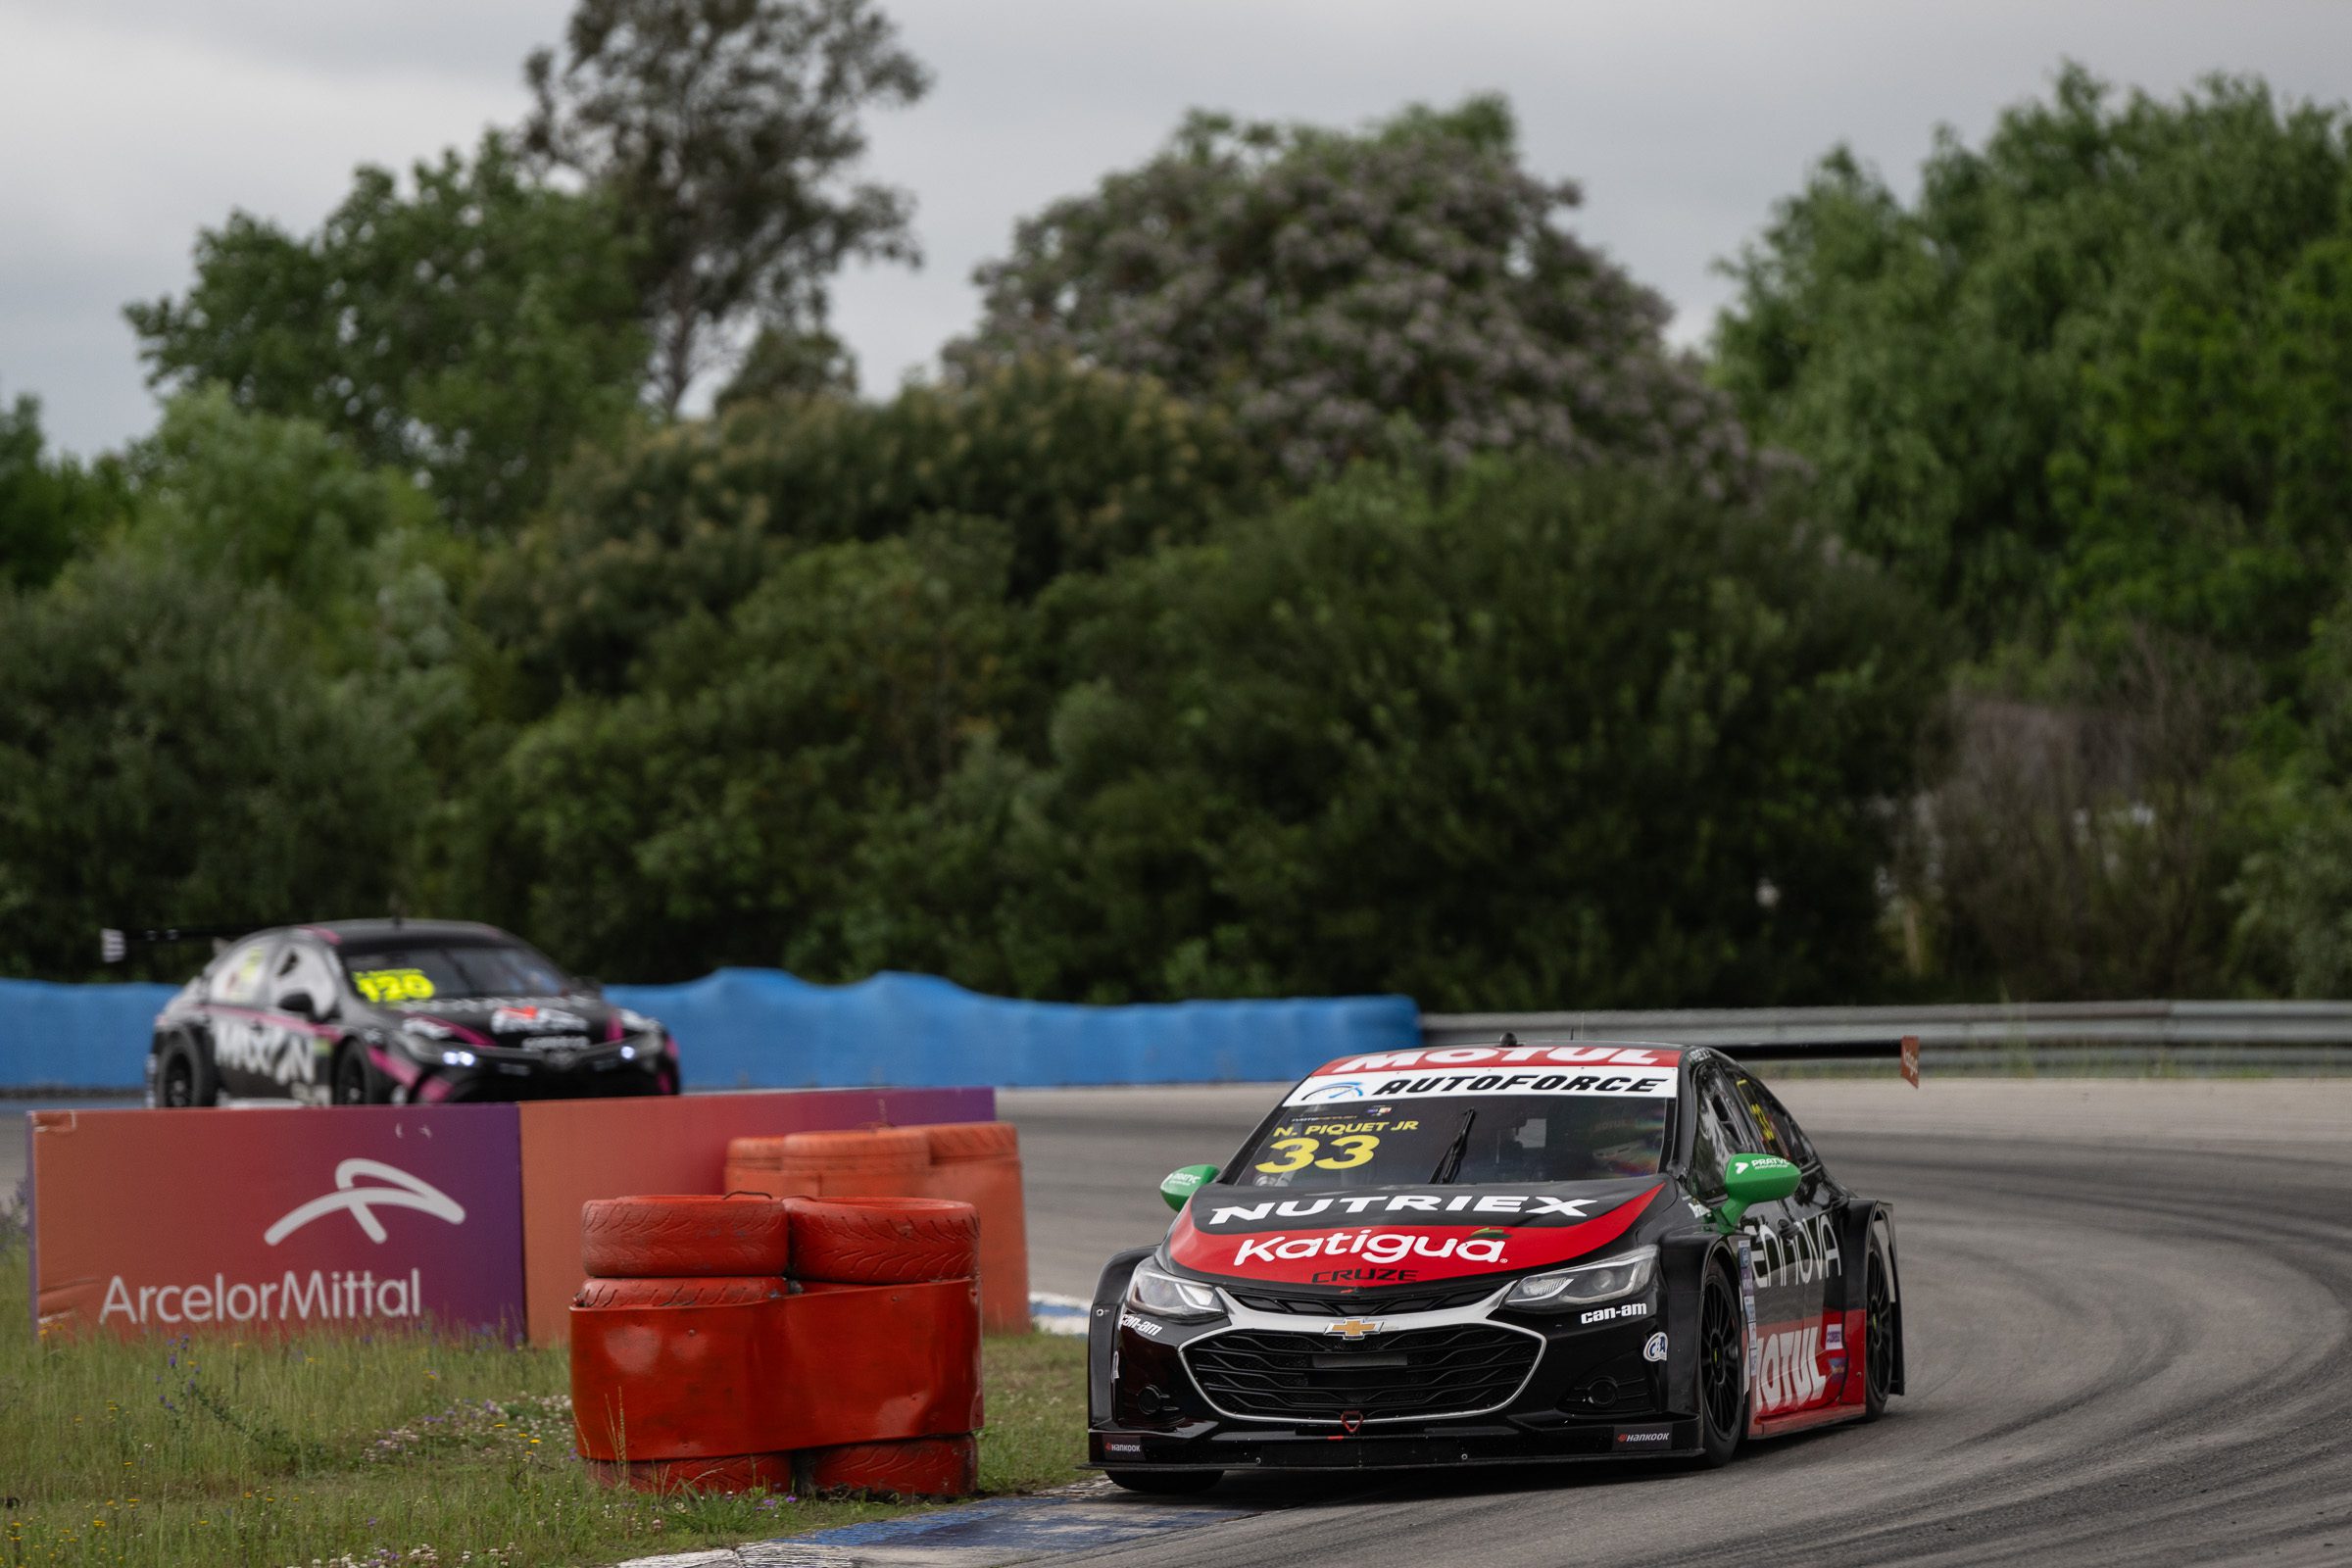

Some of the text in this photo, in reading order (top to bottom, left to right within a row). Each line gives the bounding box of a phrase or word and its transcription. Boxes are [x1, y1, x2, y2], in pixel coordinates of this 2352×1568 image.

[1332, 1046, 1659, 1073] MOTUL
[1372, 1074, 1669, 1096] AUTOFORCE
[1273, 1120, 1420, 1137] N. PIQUET JR
[1254, 1134, 1381, 1174] 33
[1208, 1195, 1598, 1225] NUTRIEX
[1311, 1268, 1419, 1284] CRUZE
[99, 1267, 421, 1325] ArcelorMittal
[1119, 1313, 1163, 1337] can-am
[1580, 1302, 1647, 1325] can-am
